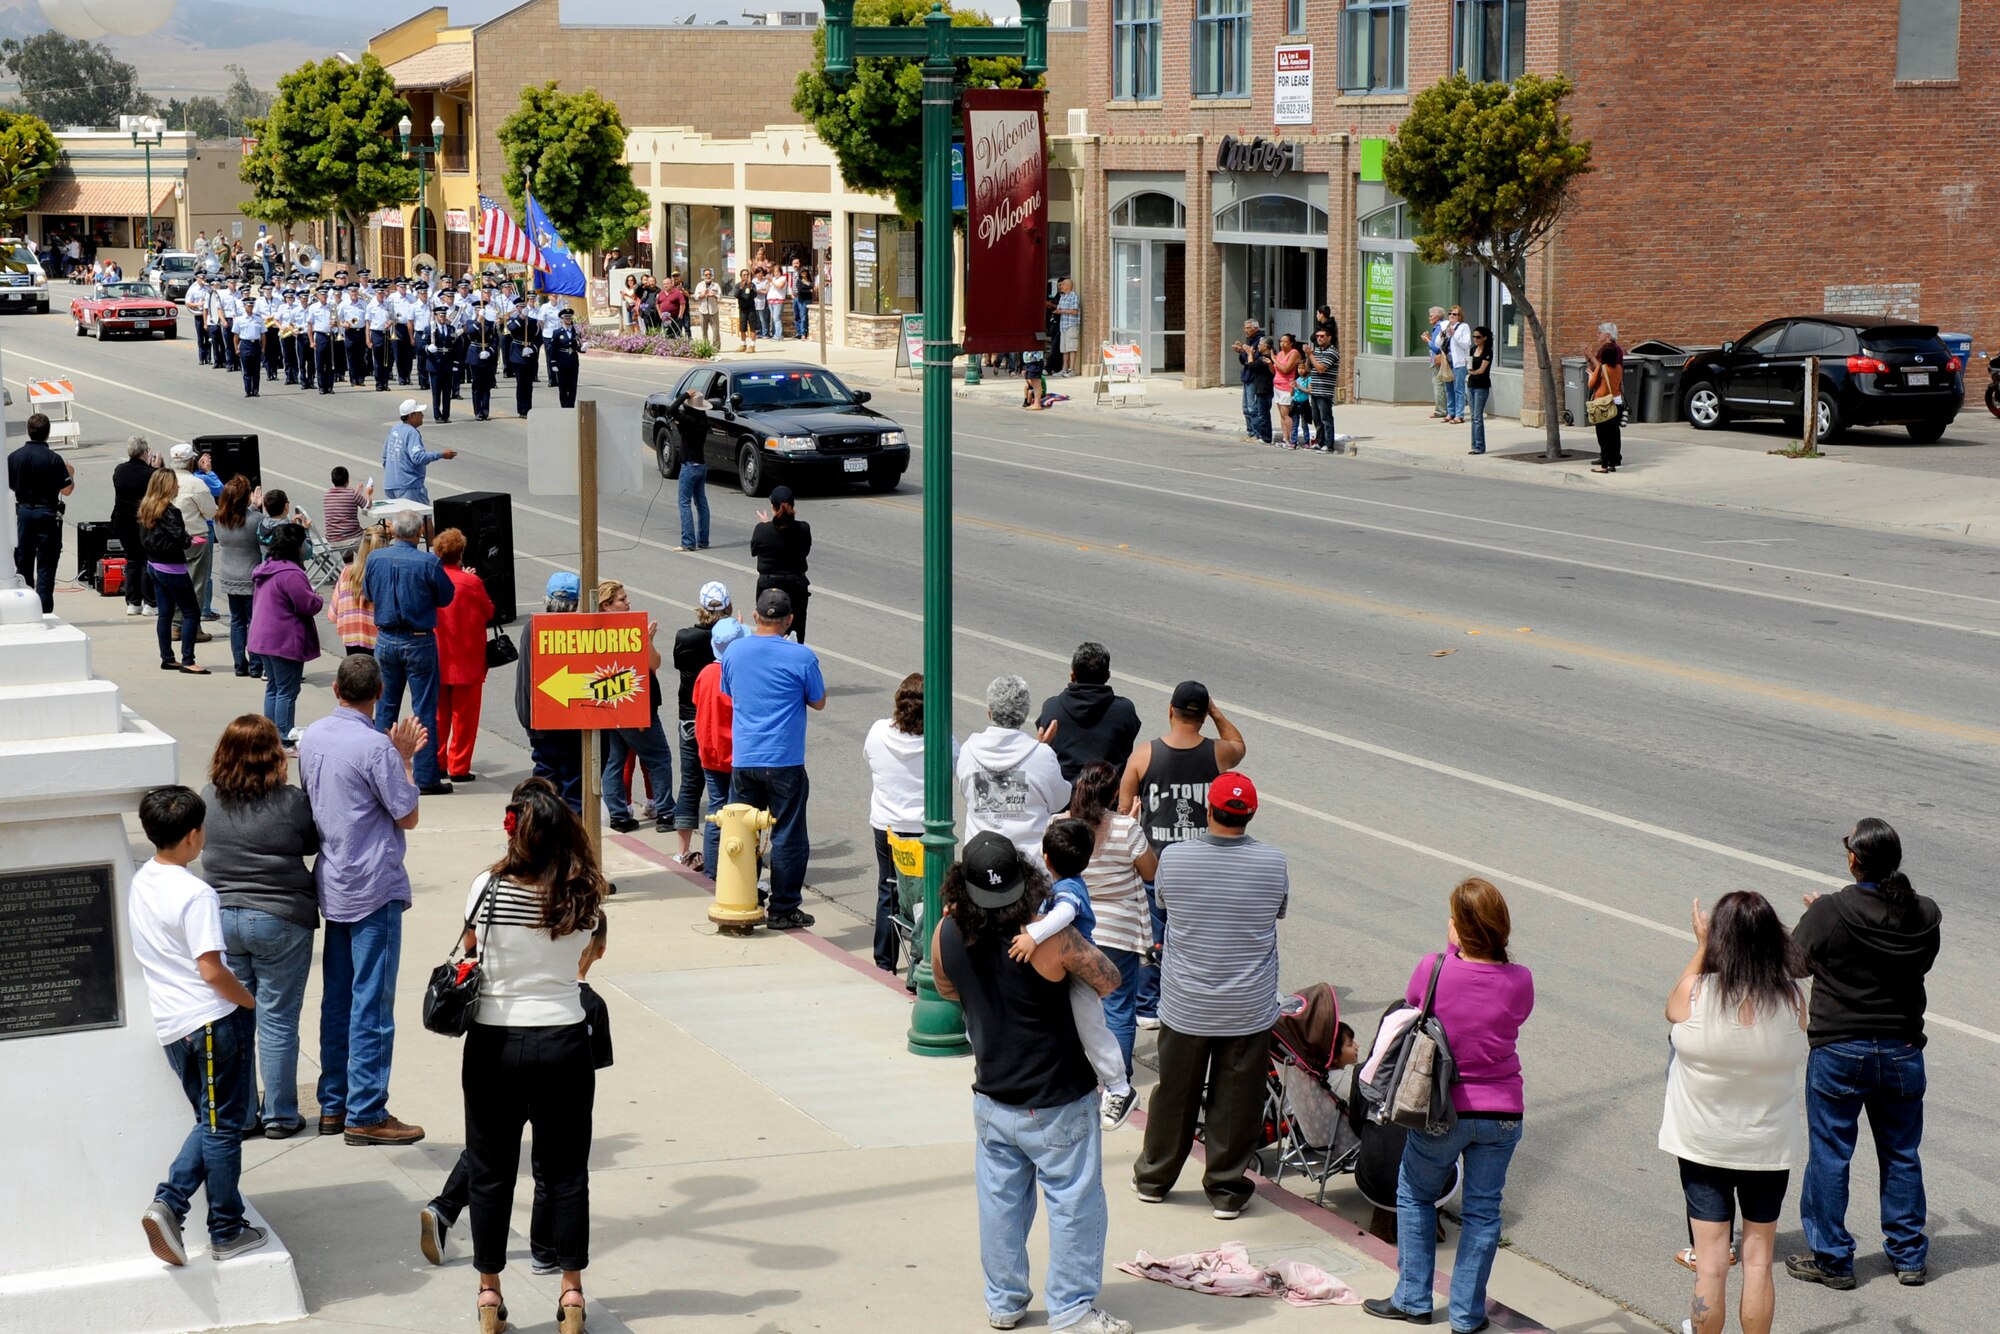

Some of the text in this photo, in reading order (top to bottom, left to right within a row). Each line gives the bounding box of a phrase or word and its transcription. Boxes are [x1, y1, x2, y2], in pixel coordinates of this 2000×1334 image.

[1278, 75, 1309, 87] FOR LEASE
[976, 113, 1037, 169] Welcome
[1216, 135, 1288, 178] Curves
[977, 152, 1040, 202] Welcome
[978, 190, 1041, 249] Welcome
[1382, 266, 1393, 277] NOT
[539, 627, 642, 654] FIREWORKS
[593, 671, 633, 700] TNT
[1151, 826, 1209, 842] BULLDOG
[2, 875, 92, 891] OF OUR THREE
[987, 869, 1003, 885] LA
[56, 885, 100, 897] BURIED
[31, 896, 94, 909] CEMETERY
[24, 913, 76, 925] CARRASCO
[29, 923, 73, 934] BATTALION
[31, 945, 92, 958] HERNANDEZ
[31, 955, 76, 966] BATTALION
[53, 988, 70, 997] DIV.
[30, 1011, 57, 1021] ACTION
